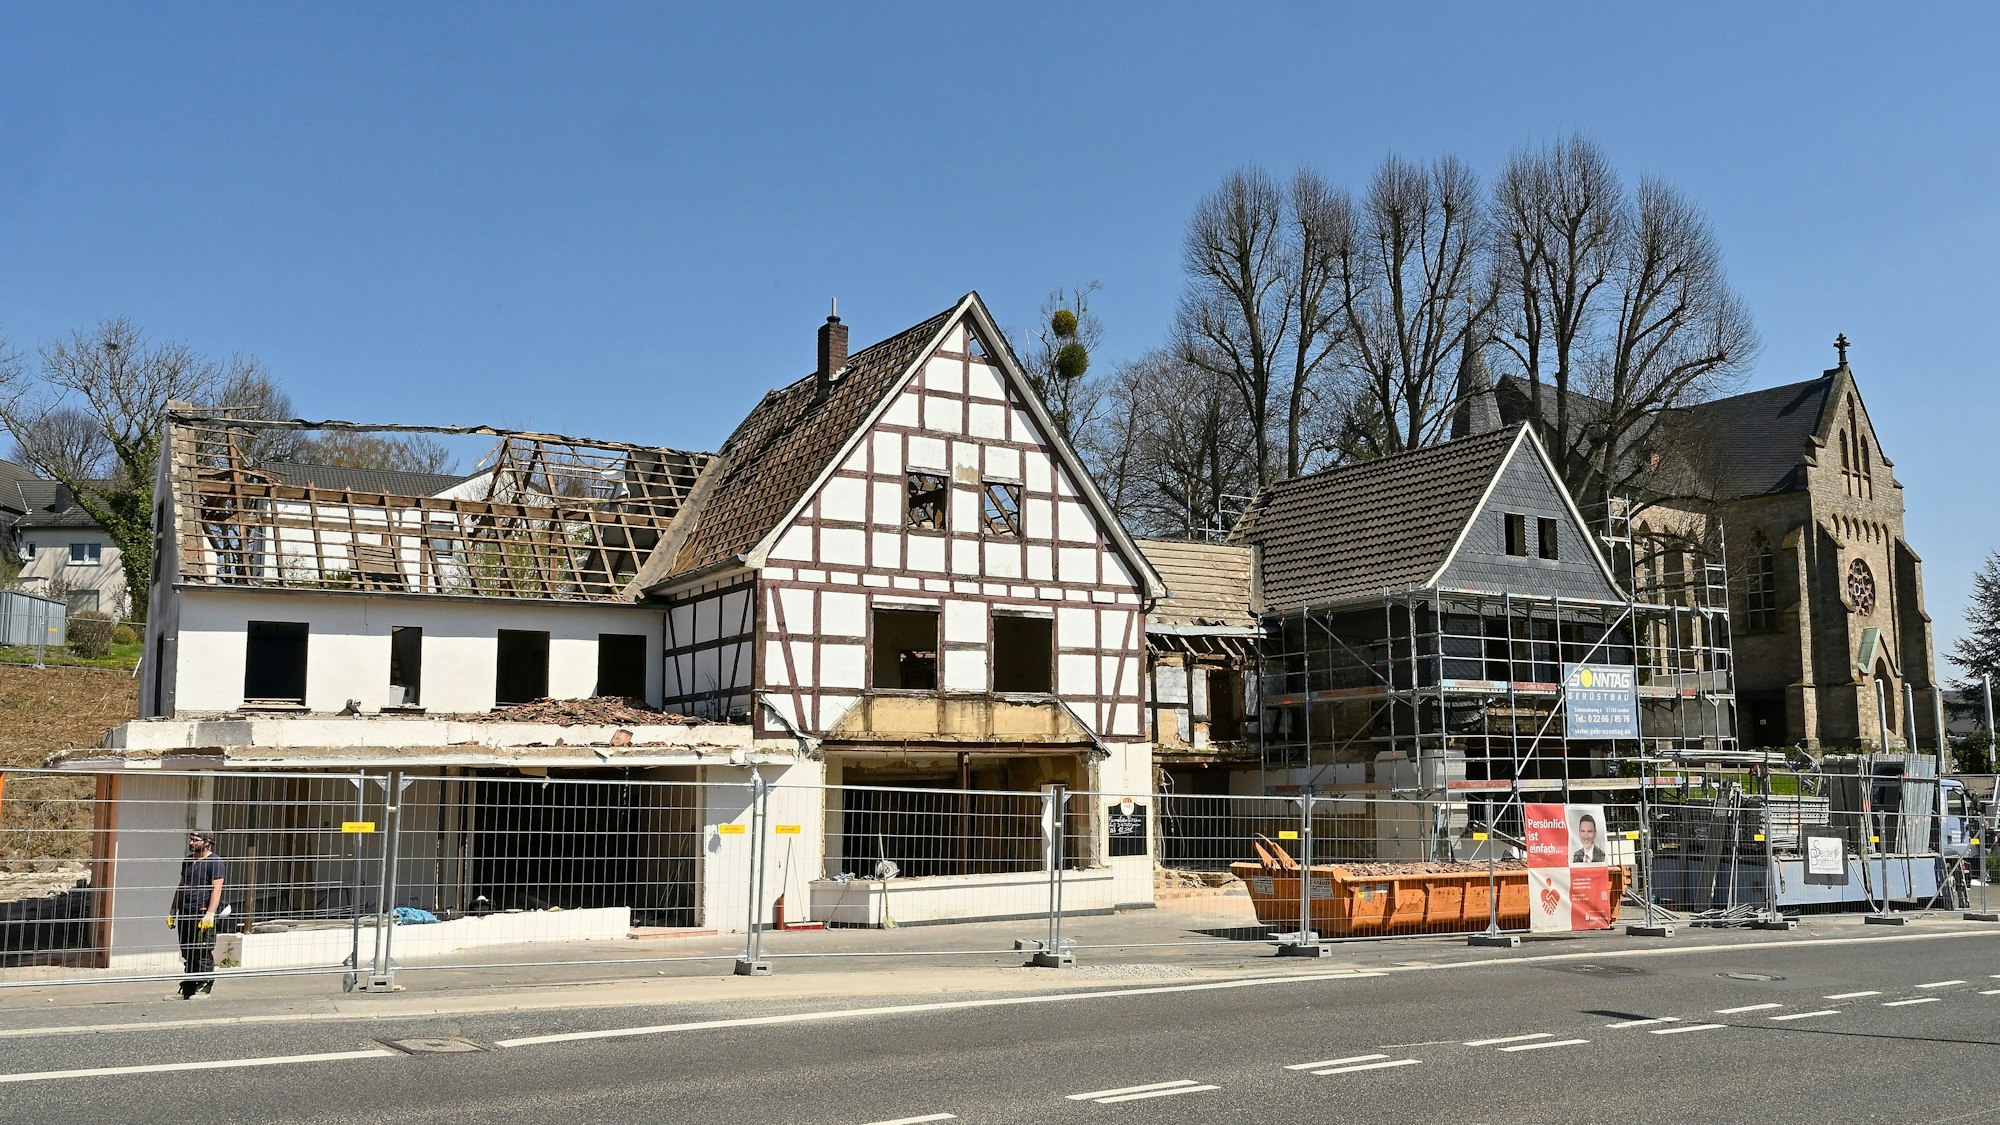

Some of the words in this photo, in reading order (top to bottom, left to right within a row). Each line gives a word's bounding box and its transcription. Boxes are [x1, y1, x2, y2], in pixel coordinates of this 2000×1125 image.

[1569, 667, 1631, 688] SONNTAG
[1568, 692, 1629, 701] GERÜSTBAU
[1588, 714, 1592, 723] 0
[1593, 714, 1600, 723] 22
[1601, 714, 1609, 723] 66
[1623, 714, 1631, 723] 76
[1528, 819, 1567, 829] Persönlich
[1528, 830, 1539, 841] ist
